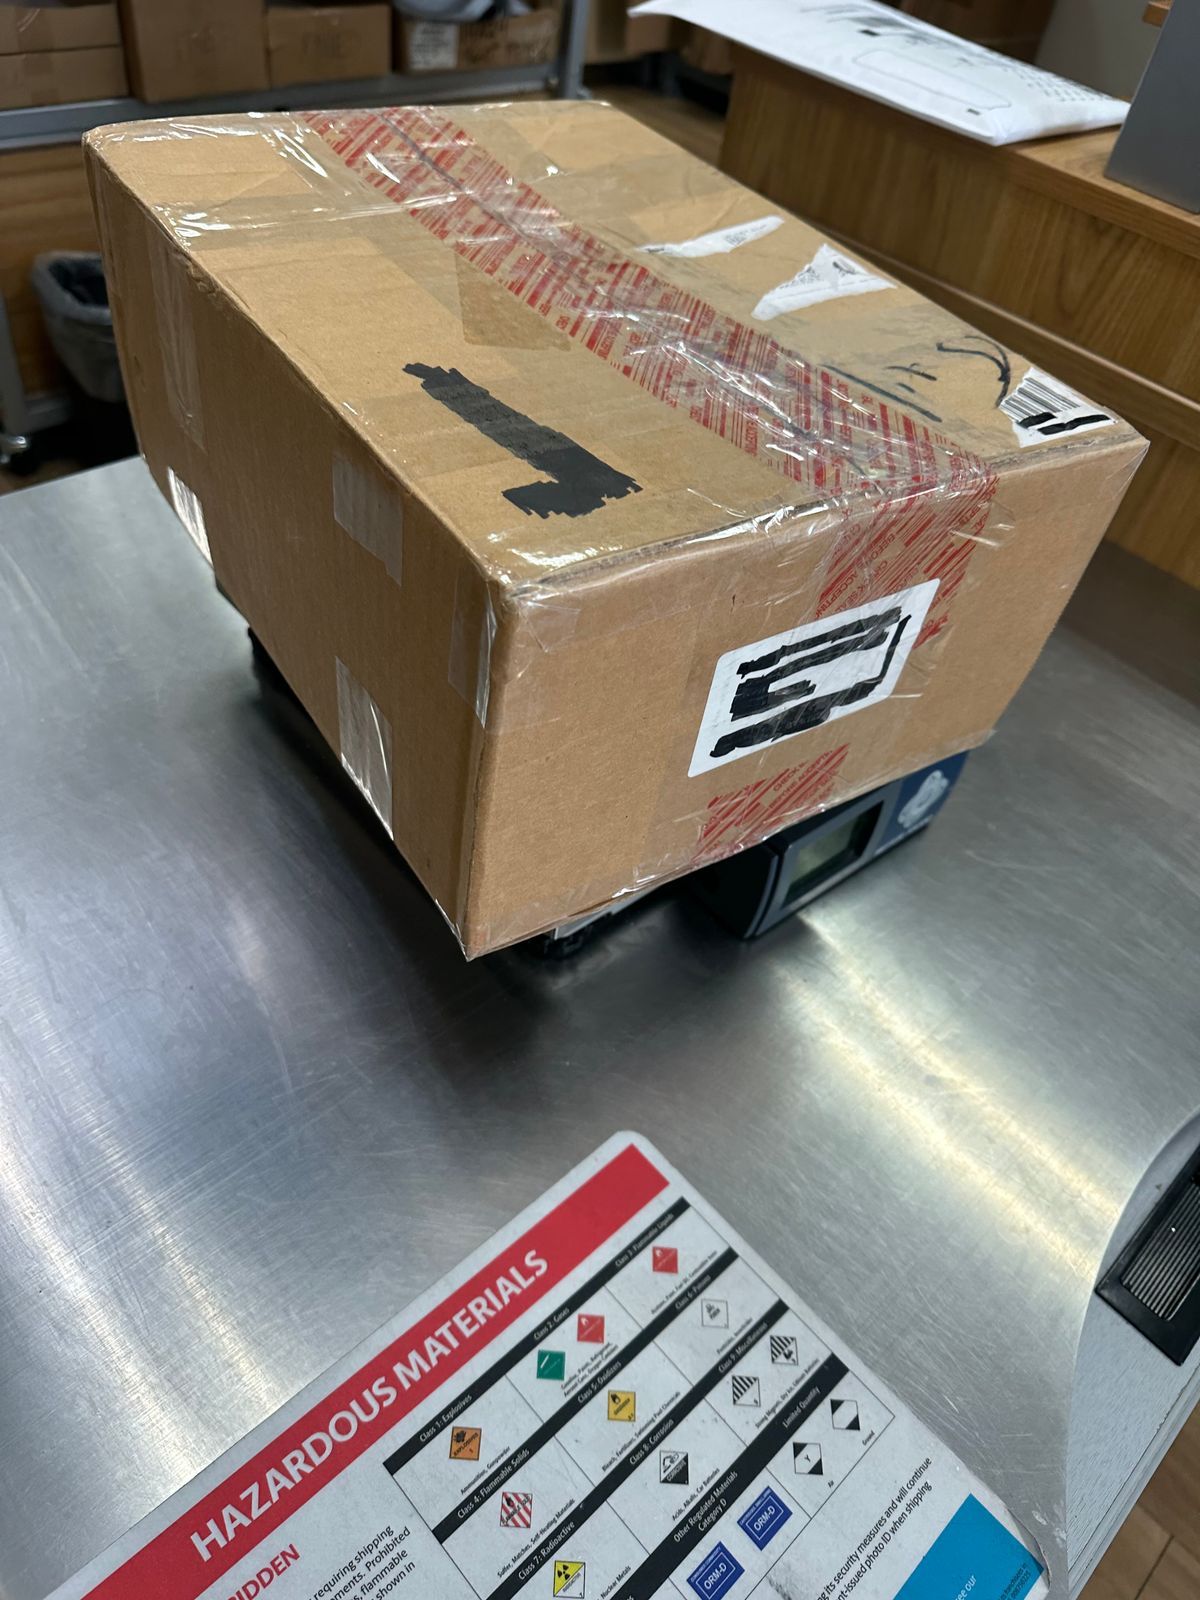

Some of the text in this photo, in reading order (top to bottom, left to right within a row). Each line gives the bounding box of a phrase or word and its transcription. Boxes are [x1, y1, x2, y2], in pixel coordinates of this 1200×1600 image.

[533, 1326, 548, 1340] Class
[553, 1307, 569, 1322] Gases
[577, 1388, 592, 1403] Class
[597, 1361, 621, 1384] Oxidizers
[190, 1250, 547, 1561] HAZARDOUS MATERIALS
[419, 1426, 436, 1442] Class
[441, 1394, 472, 1422] Explosives
[782, 1386, 820, 1428] Limited Quantity
[629, 1419, 674, 1465] Class 8: Corrosion
[804, 1454, 810, 1462] Y
[457, 1449, 529, 1518] Class 4: Flammable Solids
[555, 1498, 575, 1519] Materials
[673, 1471, 737, 1542] Other Regulated Materials
[698, 1498, 726, 1531] Category D
[753, 1505, 775, 1531] ORM-D
[823, 1458, 932, 1595] its security measures and will continue
[864, 1542, 884, 1570] photo
[881, 1532, 891, 1544] ID
[889, 1512, 908, 1535] when
[905, 1481, 932, 1514] shipping
[313, 1526, 394, 1600] requiring shipping
[365, 1526, 410, 1572] Prohibited
[518, 1521, 575, 1580] Class 7: Radioactive
[228, 1544, 300, 1600] IDDEN
[360, 1550, 407, 1595] flammable
[376, 1571, 406, 1600] shown
[404, 1562, 415, 1573] in
[600, 1580, 617, 1599] Nuclear
[616, 1565, 631, 1582] Metals
[704, 1562, 726, 1589] ORM-D
[965, 1575, 976, 1591] our
